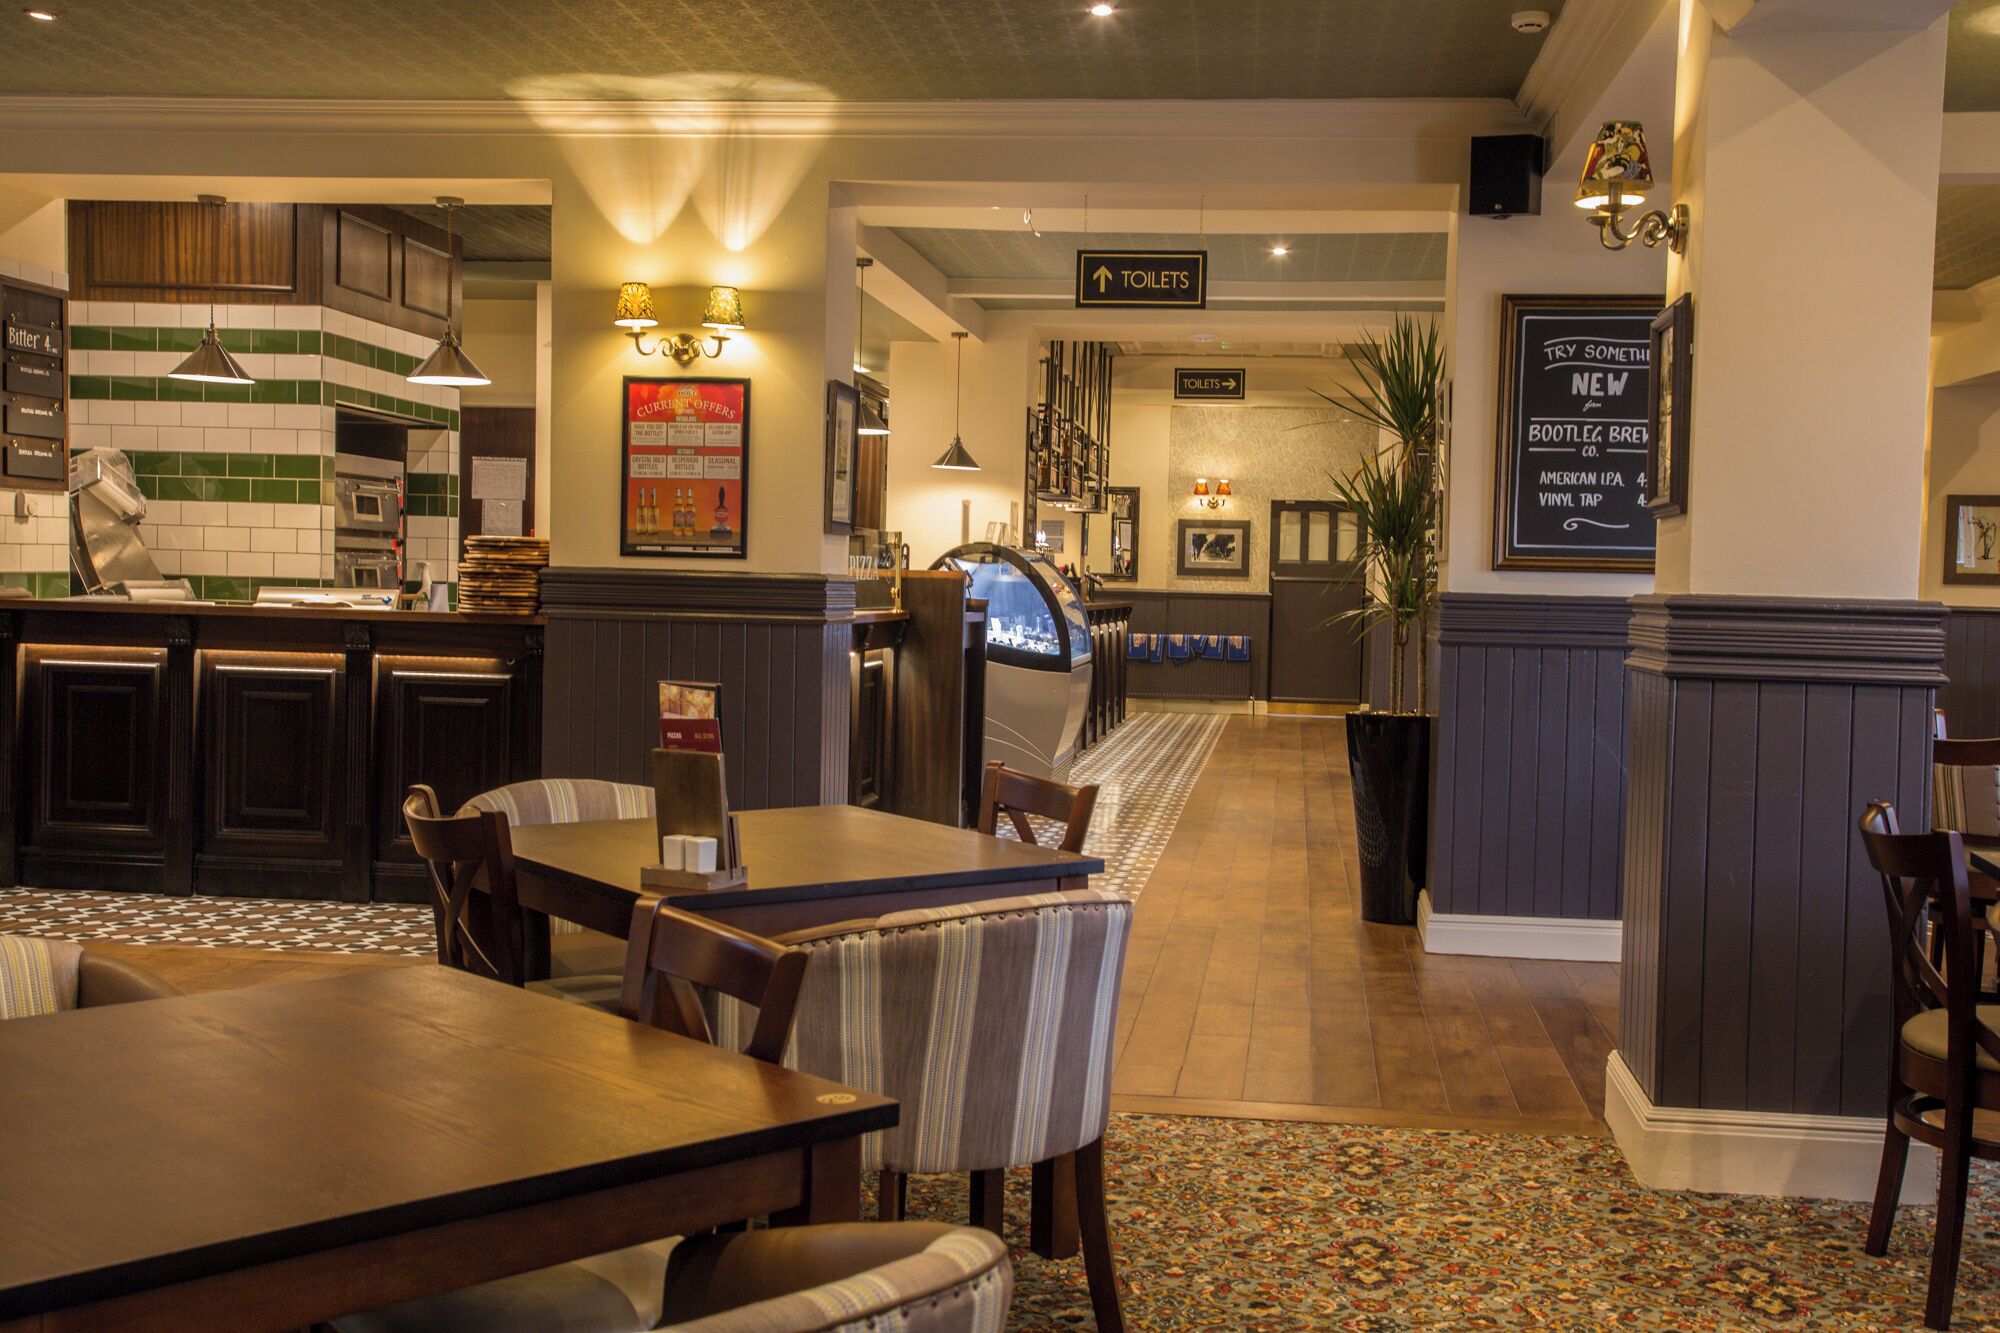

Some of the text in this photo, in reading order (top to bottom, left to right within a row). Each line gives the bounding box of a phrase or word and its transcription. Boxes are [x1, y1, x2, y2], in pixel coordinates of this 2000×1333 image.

[1121, 270, 1189, 289] TOILETS
[9, 326, 40, 349] Bitter
[1544, 343, 1577, 361] TRY
[1183, 378, 1221, 390] TOILETS
[1571, 372, 1629, 397] NEW
[637, 399, 735, 419] CURRENT OFFERS
[1529, 424, 1603, 443] BOOTLEG
[1582, 445, 1599, 457] CO.
[1539, 471, 1597, 486] AMERICAN
[1539, 492, 1575, 507] VINYL
[1579, 493, 1603, 507] TAP
[849, 555, 879, 581] PIZZA
